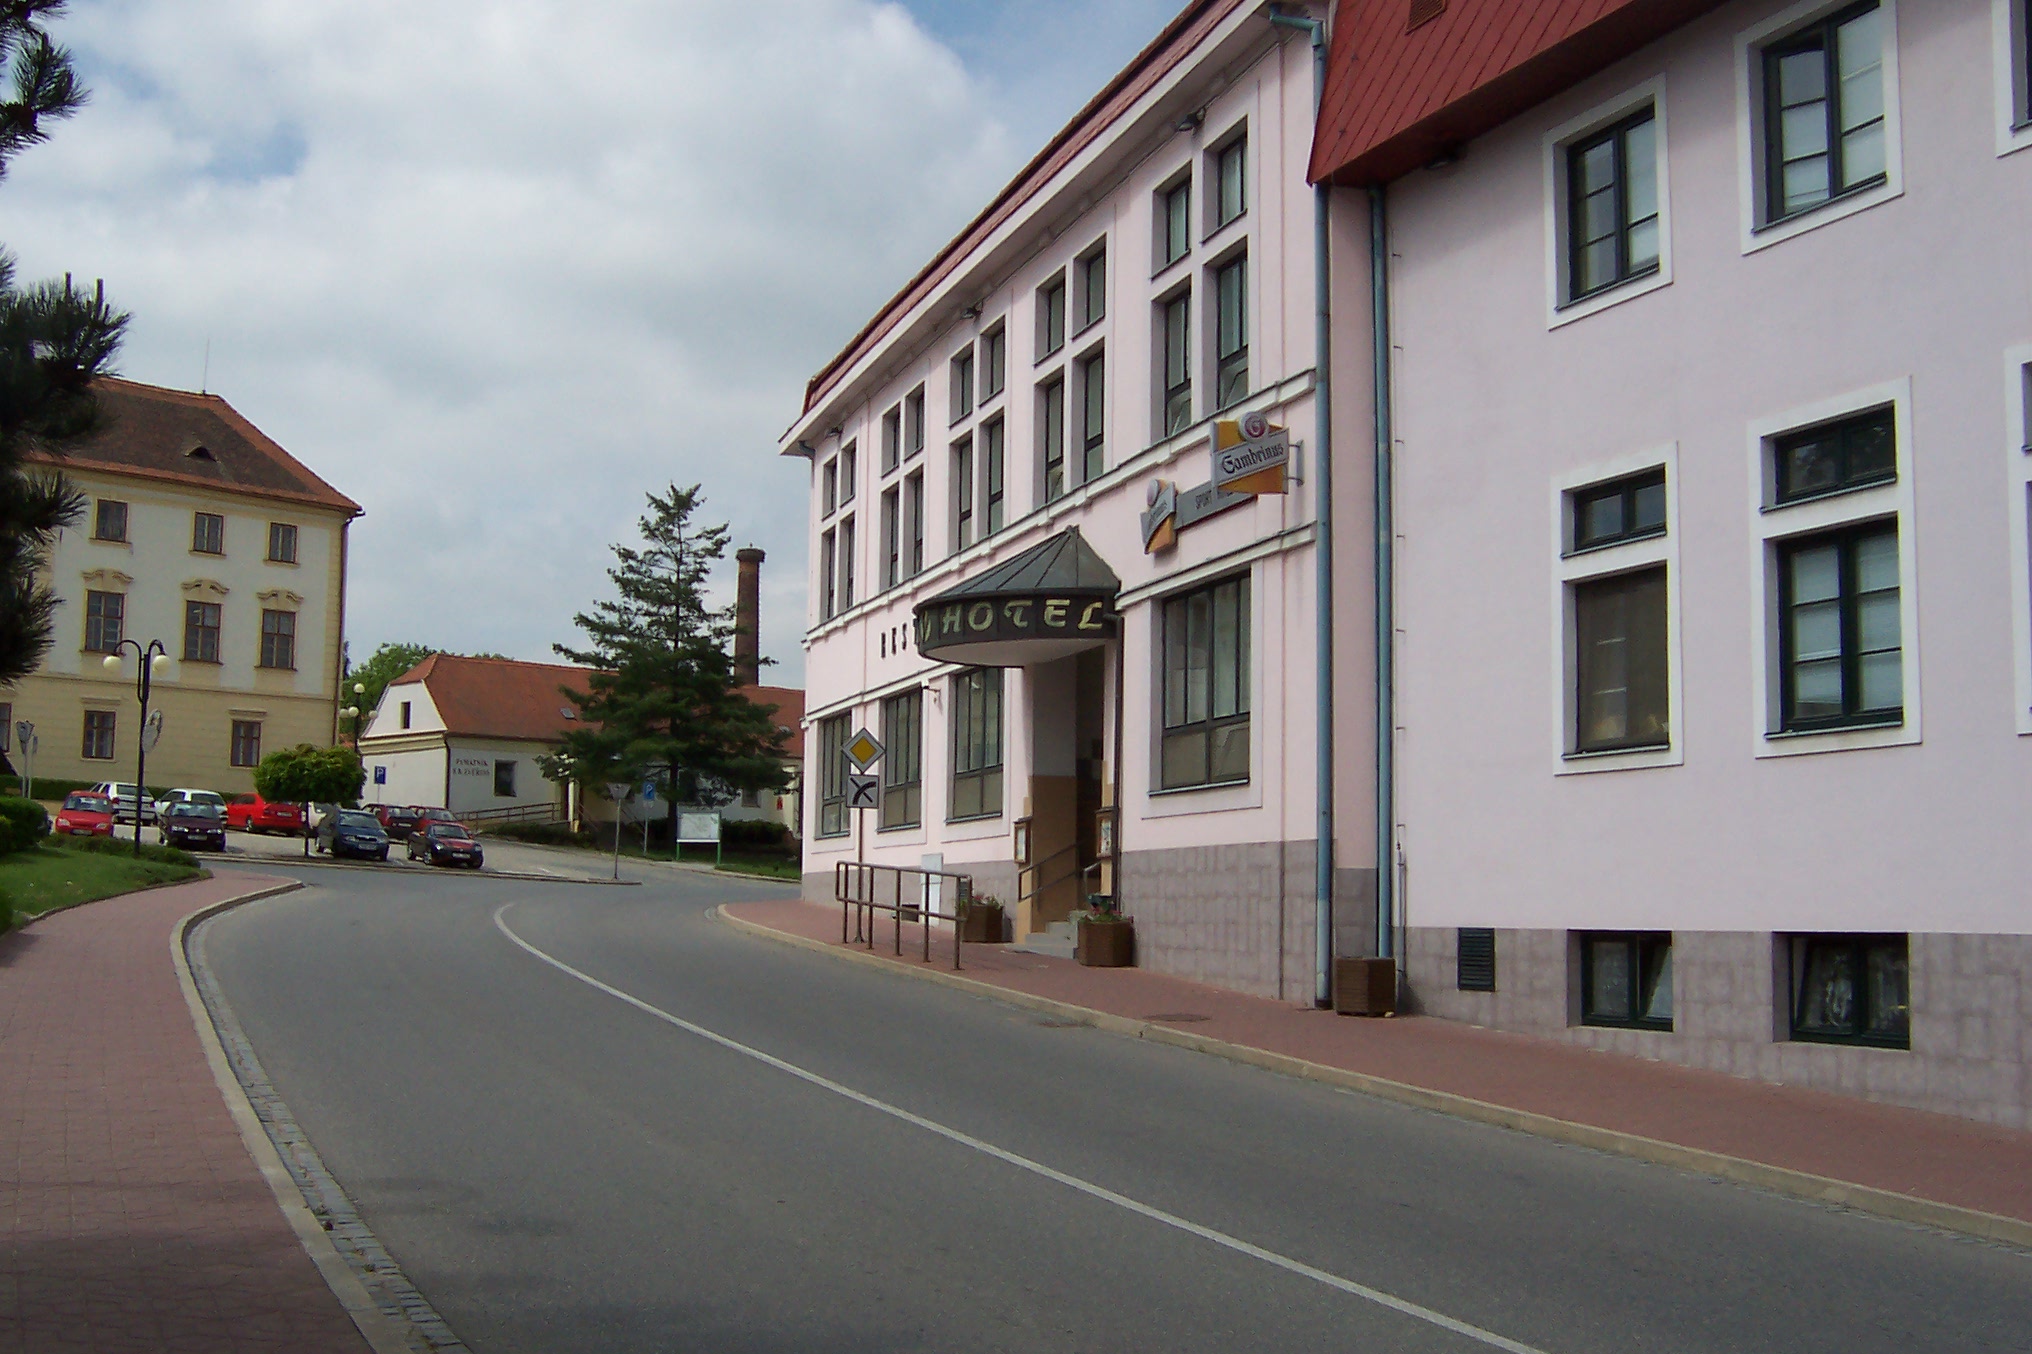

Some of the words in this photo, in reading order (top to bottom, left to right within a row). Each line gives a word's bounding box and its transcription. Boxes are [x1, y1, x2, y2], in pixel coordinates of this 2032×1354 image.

[1221, 443, 1285, 474] Gambrinus
[942, 598, 1103, 635] HOTEL
[376, 766, 384, 778] P
